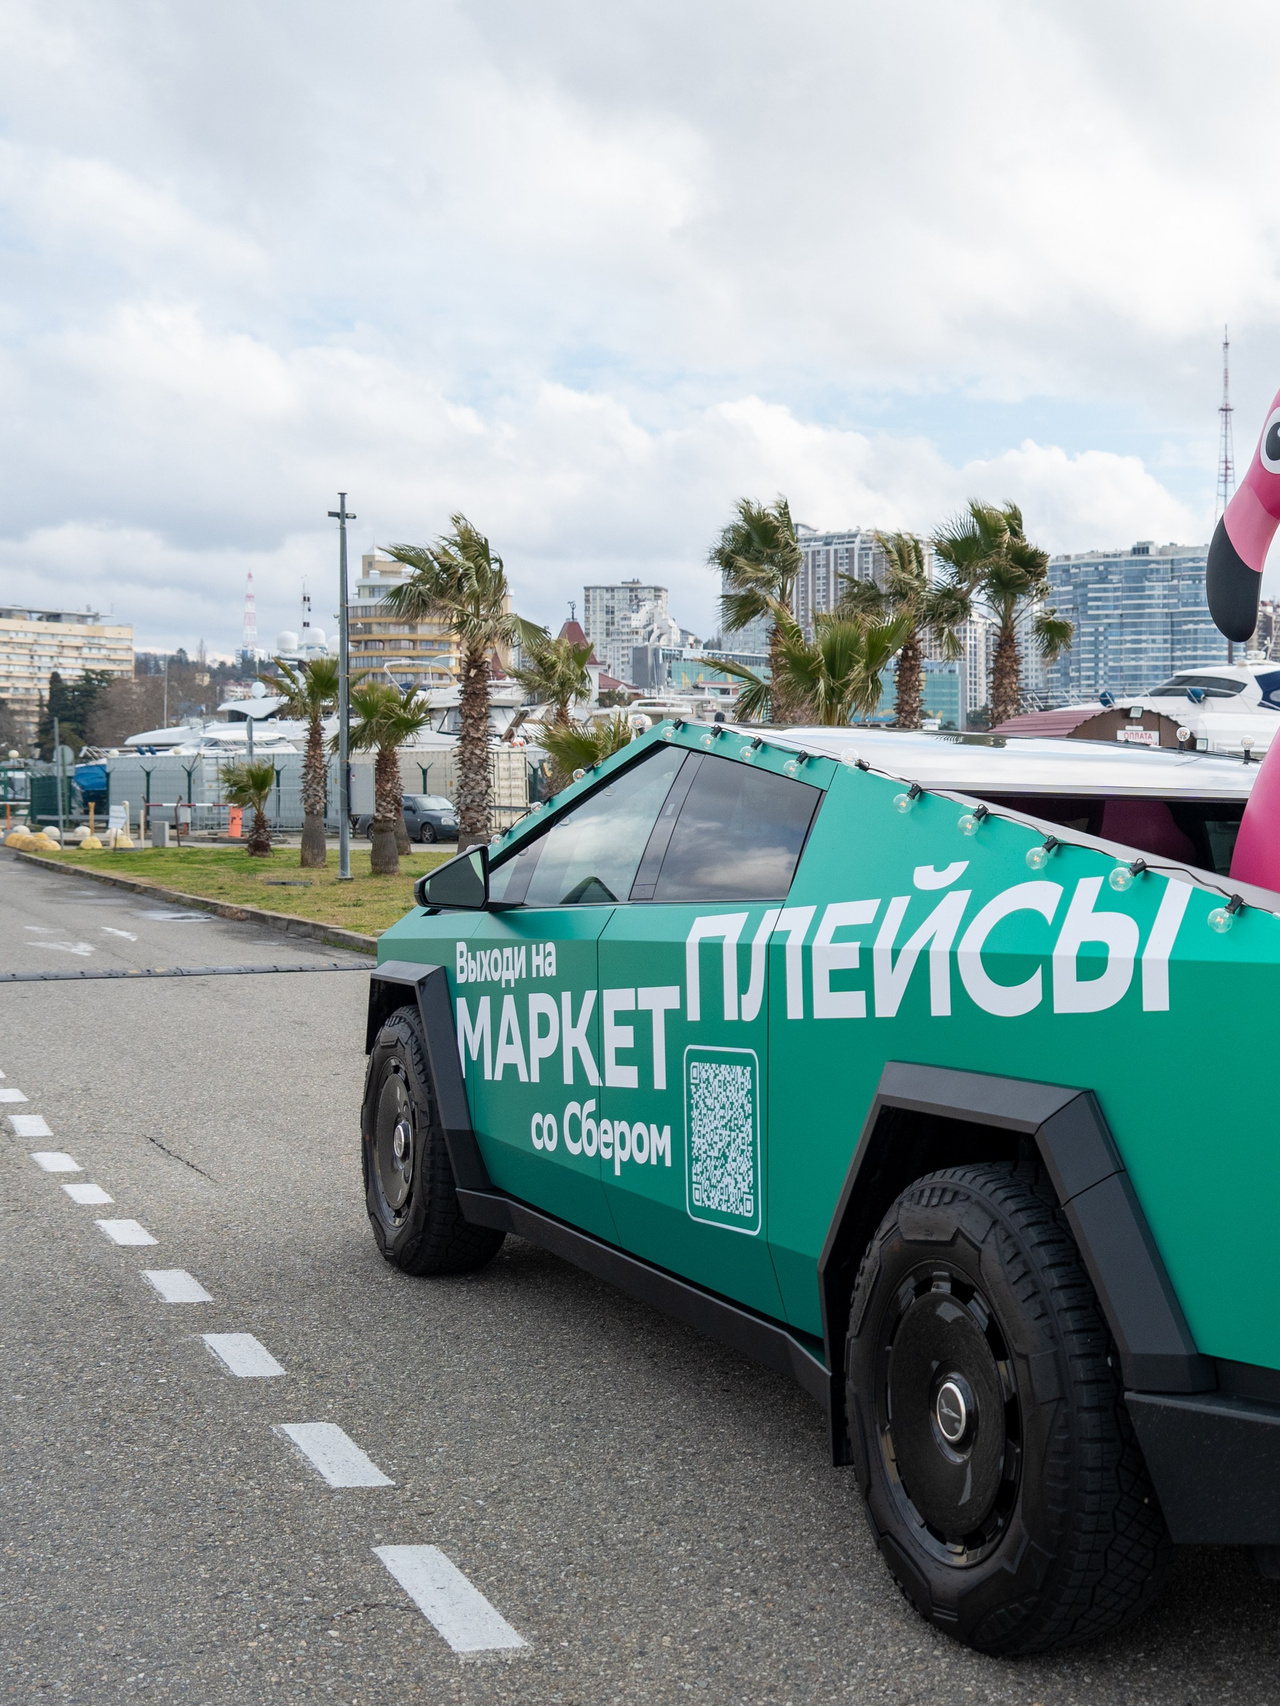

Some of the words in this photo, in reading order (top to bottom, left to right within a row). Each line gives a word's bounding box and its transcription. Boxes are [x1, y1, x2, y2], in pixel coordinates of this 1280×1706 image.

[1123, 731, 1153, 740] ОПЛАТА
[456, 941, 527, 988] Выходи
[532, 943, 557, 977] на
[456, 985, 681, 1090] МАРКЕТ
[685, 860, 1193, 1022] ПЛЕЙСЫ
[531, 1113, 557, 1152] со
[563, 1099, 672, 1176] Сбером
